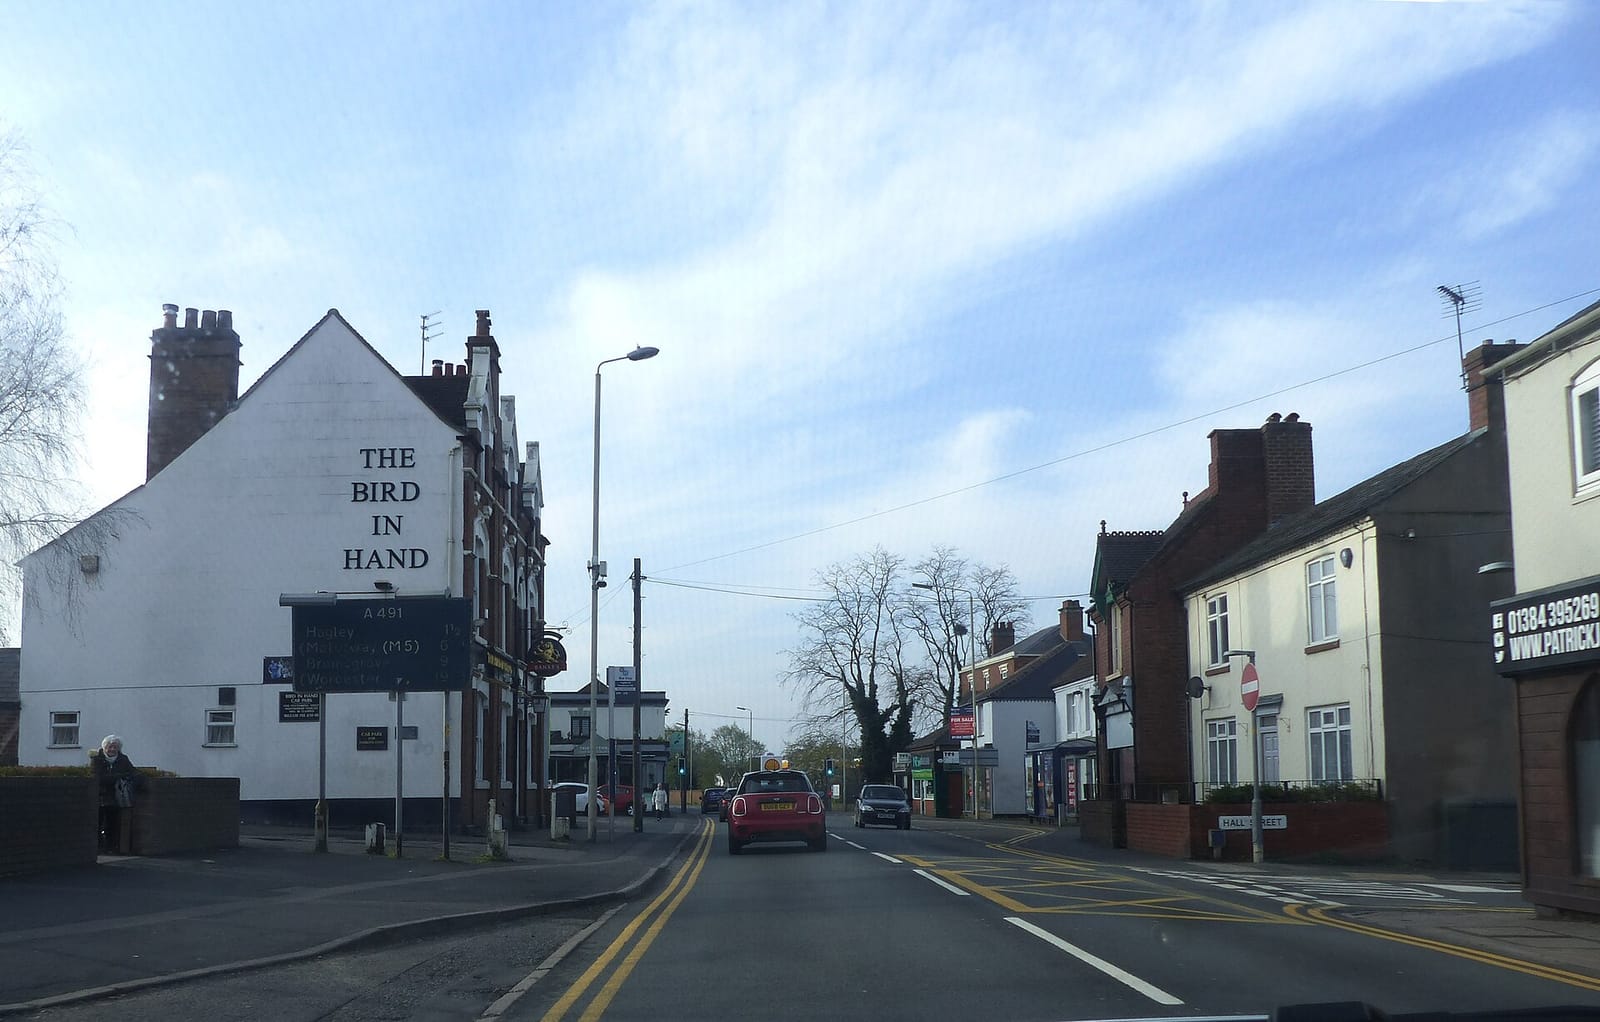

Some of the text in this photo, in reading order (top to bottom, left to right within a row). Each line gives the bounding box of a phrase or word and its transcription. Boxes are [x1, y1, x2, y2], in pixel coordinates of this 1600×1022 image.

[359, 447, 416, 469] THE
[351, 481, 421, 503] BIRD
[371, 515, 404, 536] IN
[342, 548, 429, 570] HAND
[363, 607, 403, 619] A 491
[1507, 592, 1599, 634] 01384 395269
[1222, 818, 1282, 827] HALL SREET
